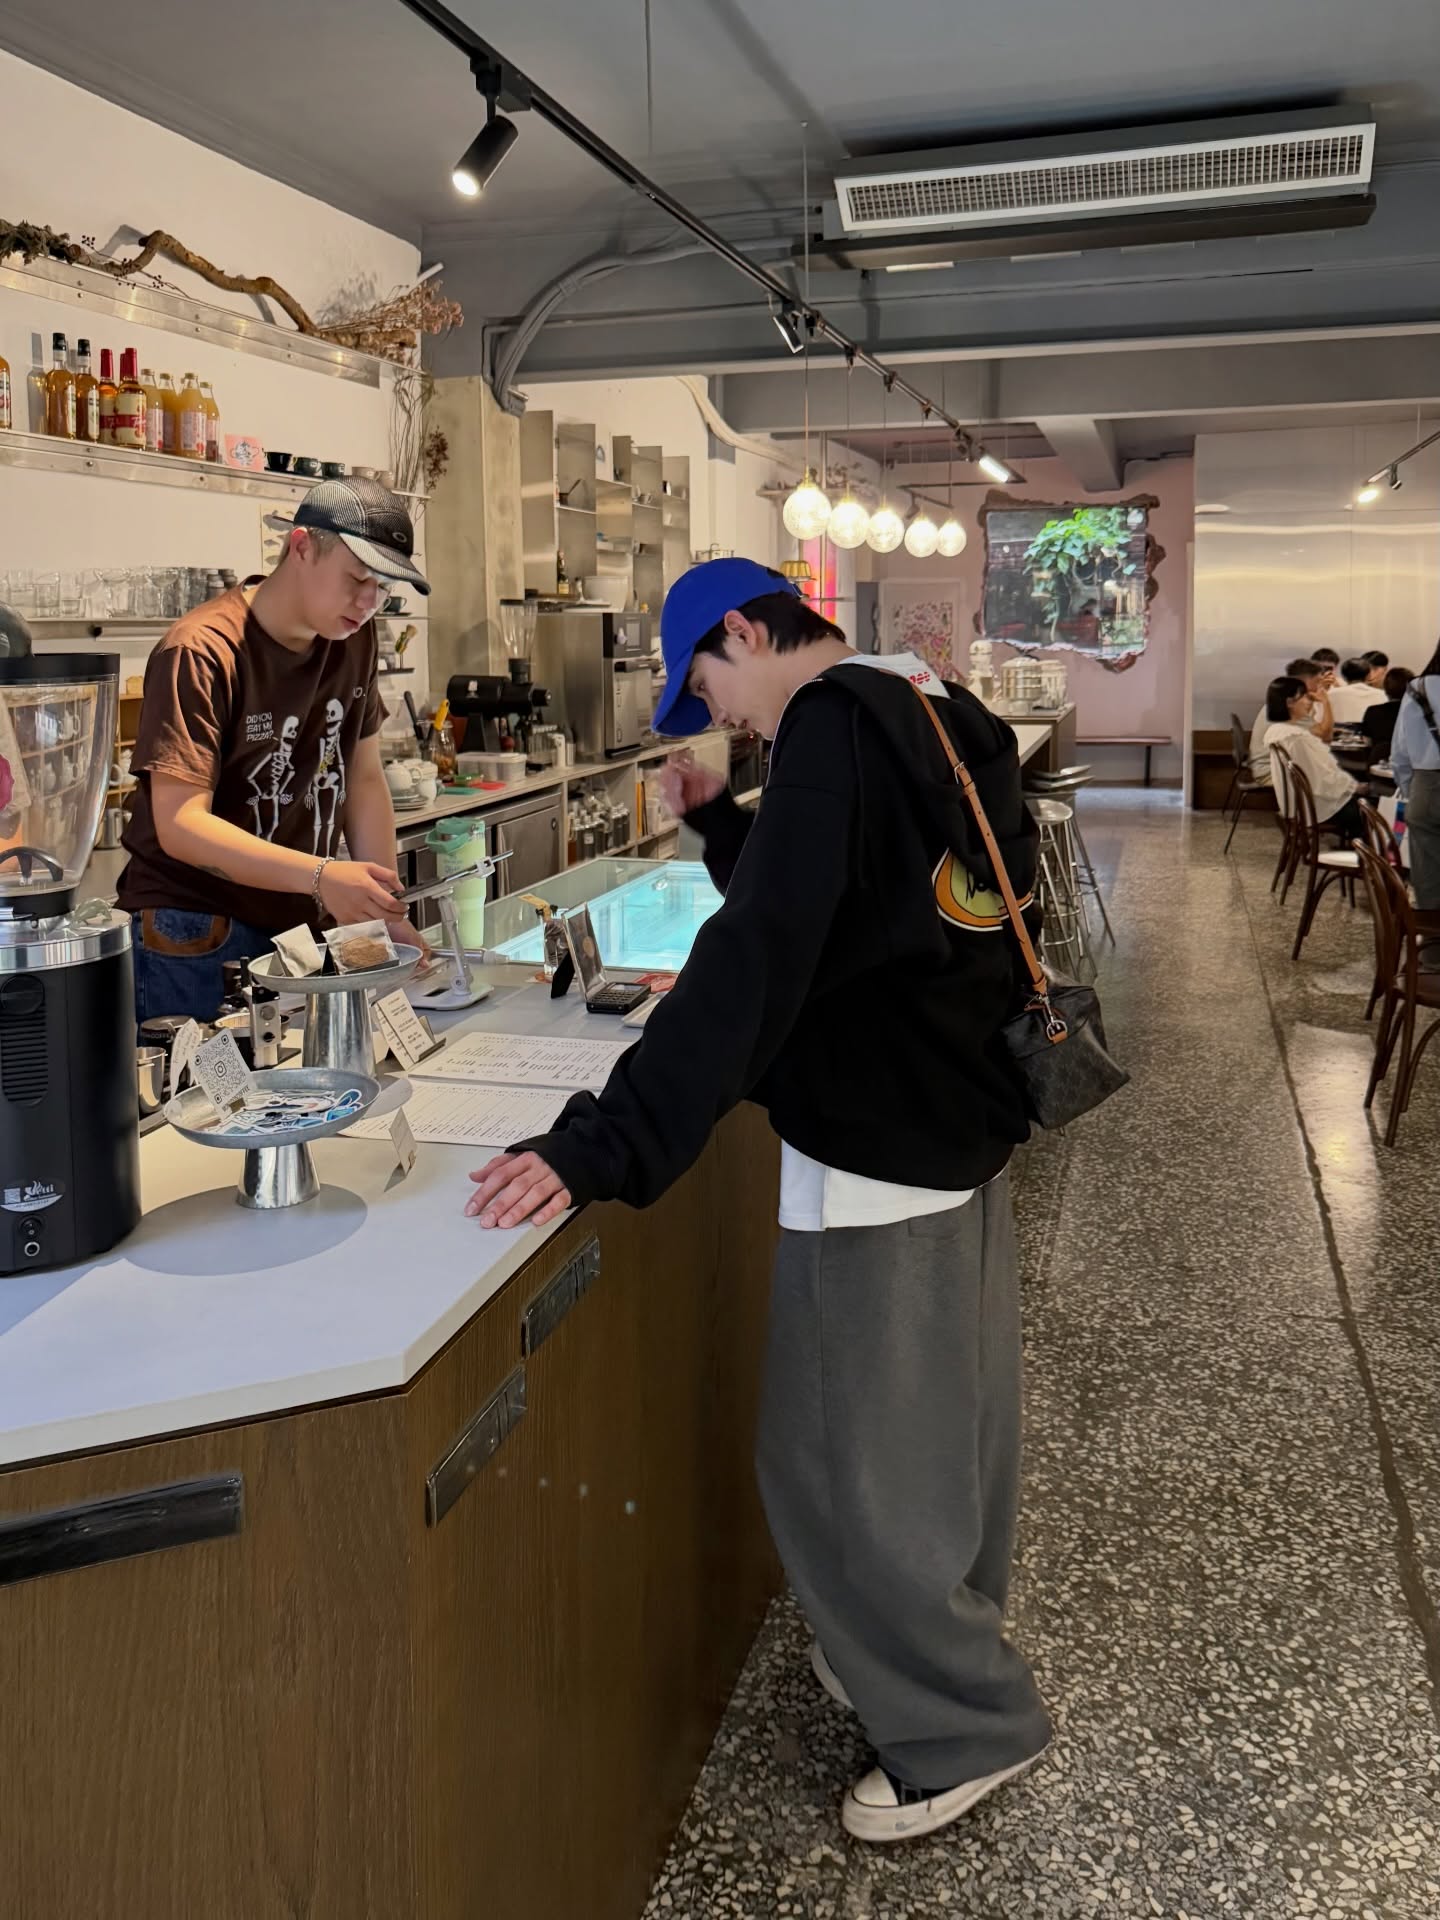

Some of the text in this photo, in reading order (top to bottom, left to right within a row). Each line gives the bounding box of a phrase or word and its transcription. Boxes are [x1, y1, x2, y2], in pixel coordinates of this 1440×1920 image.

[246, 712, 272, 724] DID YOU
[247, 721, 272, 732] EAT MY
[246, 730, 274, 742] PIZZA?
